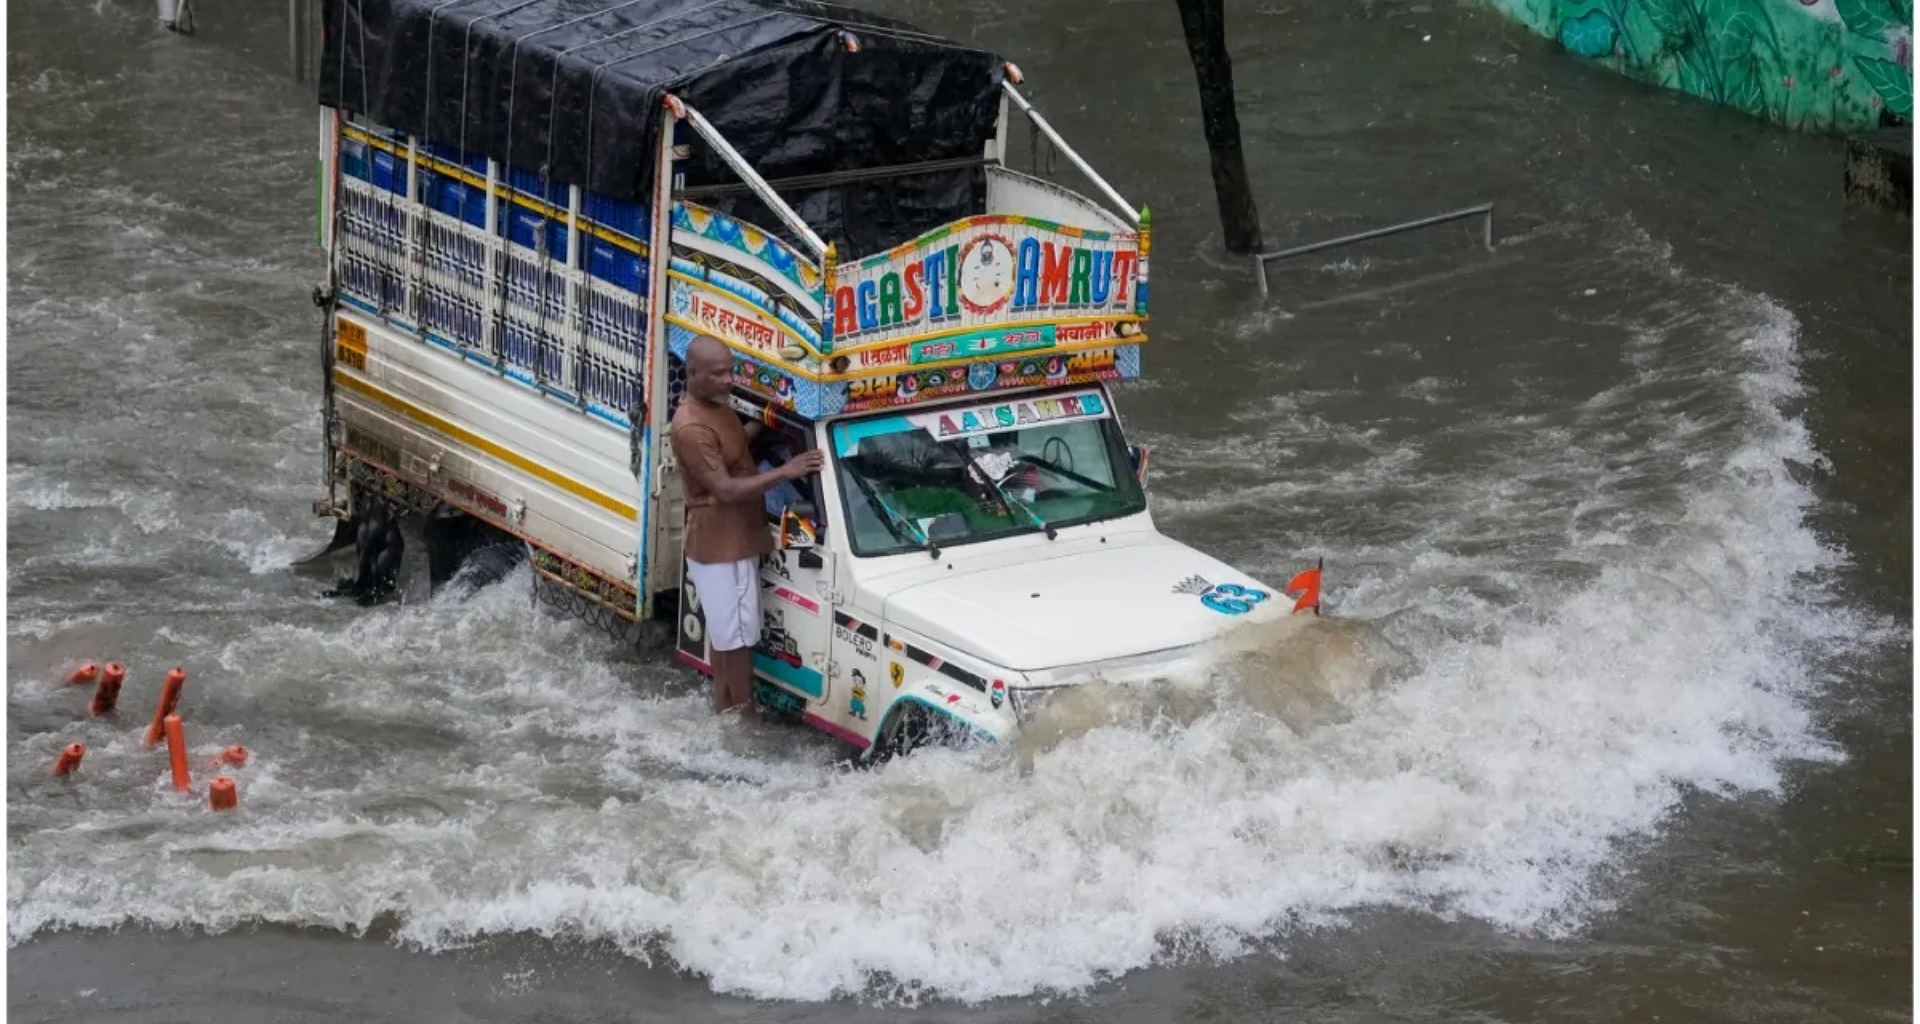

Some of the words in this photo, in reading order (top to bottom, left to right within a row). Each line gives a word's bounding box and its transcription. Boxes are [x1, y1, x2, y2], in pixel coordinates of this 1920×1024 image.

[834, 244, 960, 335] AGASTI
[1013, 236, 1138, 308] AMRUT
[702, 301, 716, 329] हर
[719, 308, 734, 332] हर
[735, 314, 774, 350] महादेव
[938, 393, 1105, 437] AAISAHEB
[1201, 582, 1268, 615] 63
[836, 626, 873, 652] BOLERO
